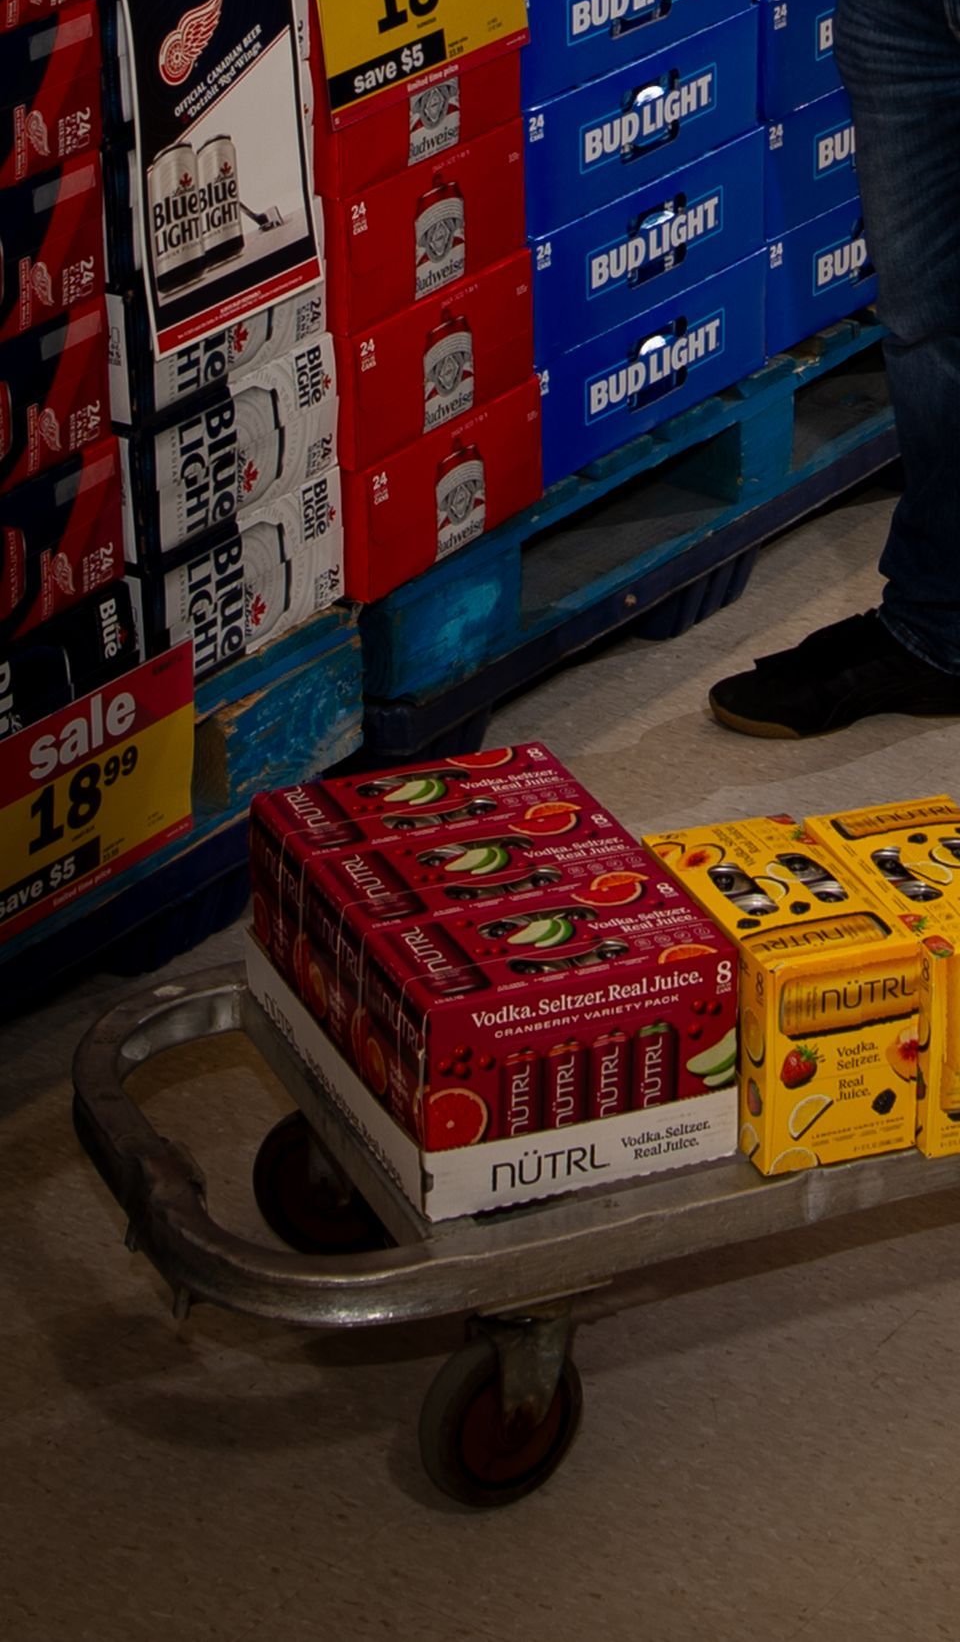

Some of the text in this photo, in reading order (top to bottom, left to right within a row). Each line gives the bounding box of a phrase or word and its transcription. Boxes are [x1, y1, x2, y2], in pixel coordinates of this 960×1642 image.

[173, 23, 263, 116] OFFICIAL CANADIAN BEER
[353, 46, 425, 96] save $5
[153, 190, 199, 232] Blue
[155, 216, 200, 257] LIGHT
[591, 196, 719, 288] BUD LIGHT
[28, 690, 138, 782] sale
[49, 855, 77, 889] $5
[715, 959, 733, 986] 8
[471, 967, 704, 1030] Vodka. Seltzer. Real Juice.
[494, 993, 681, 1040] CRANBERRY VARIETY PACK
[836, 1042, 879, 1058] Vodka.
[836, 1053, 881, 1071] Seltzer.
[620, 1119, 712, 1150] Vodka. Seltzer.
[633, 1135, 701, 1160] Real Juice.
[491, 1142, 611, 1193] NÜTRL
